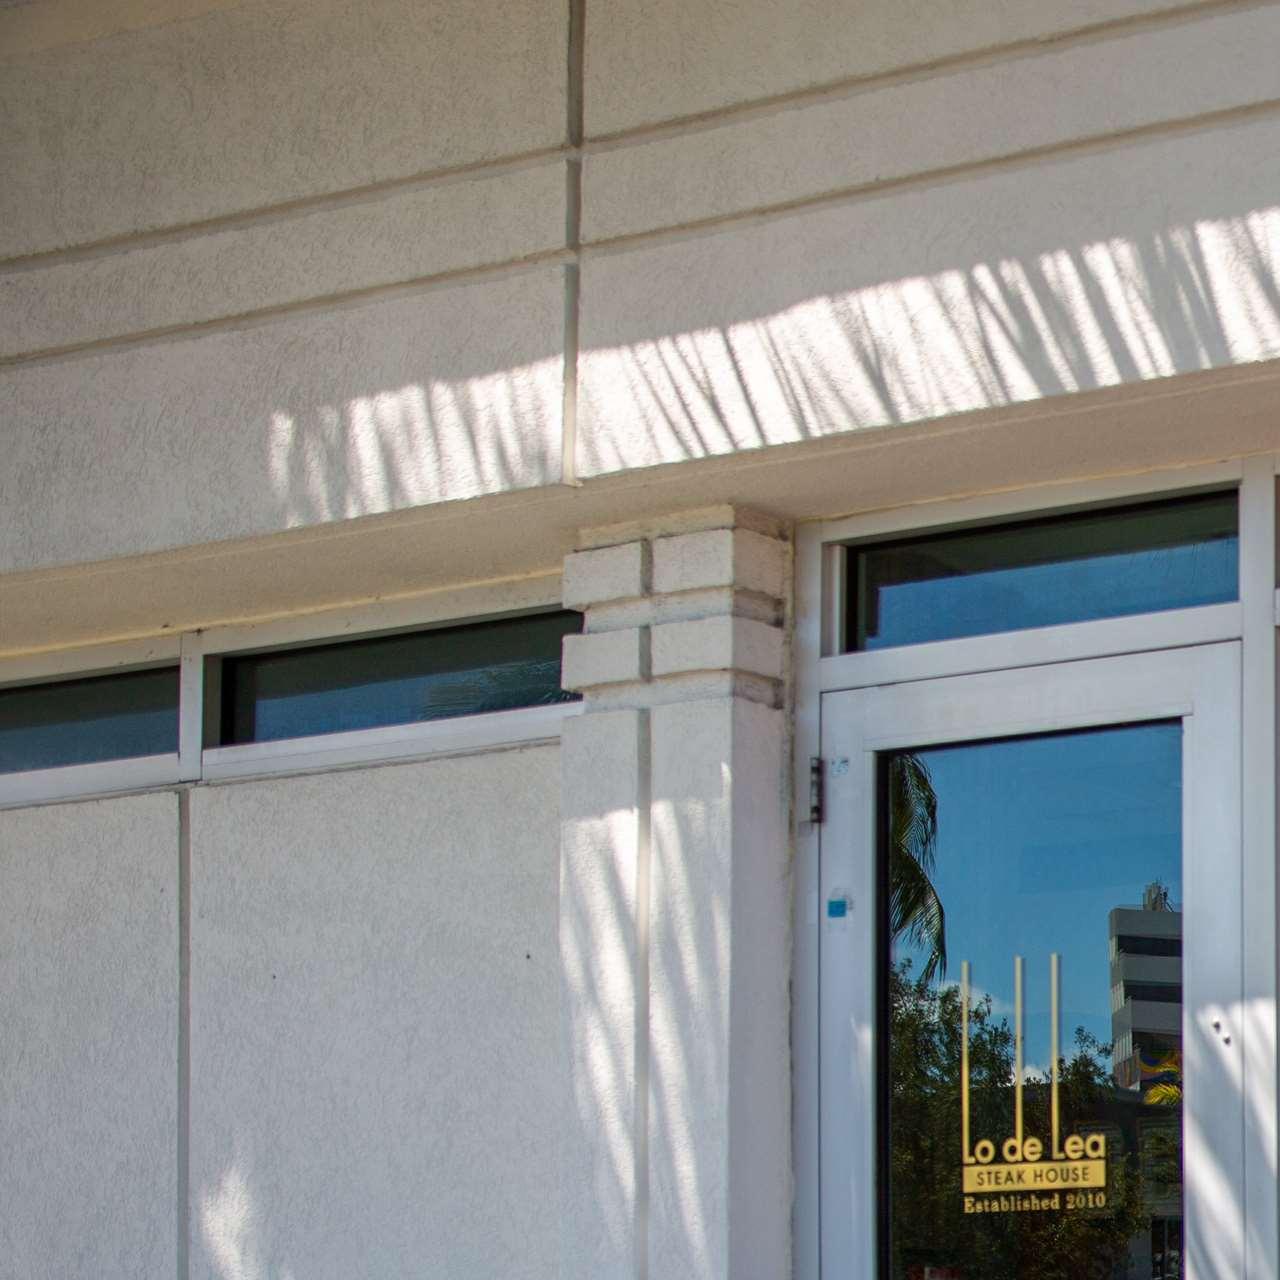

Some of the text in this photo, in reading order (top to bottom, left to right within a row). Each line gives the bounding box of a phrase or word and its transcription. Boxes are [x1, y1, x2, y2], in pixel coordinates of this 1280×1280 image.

[962, 951, 1106, 1164] Lo de Lea
[976, 1165, 1090, 1187] STEAK HOUSE
[963, 1191, 1106, 1214] Established 2010
